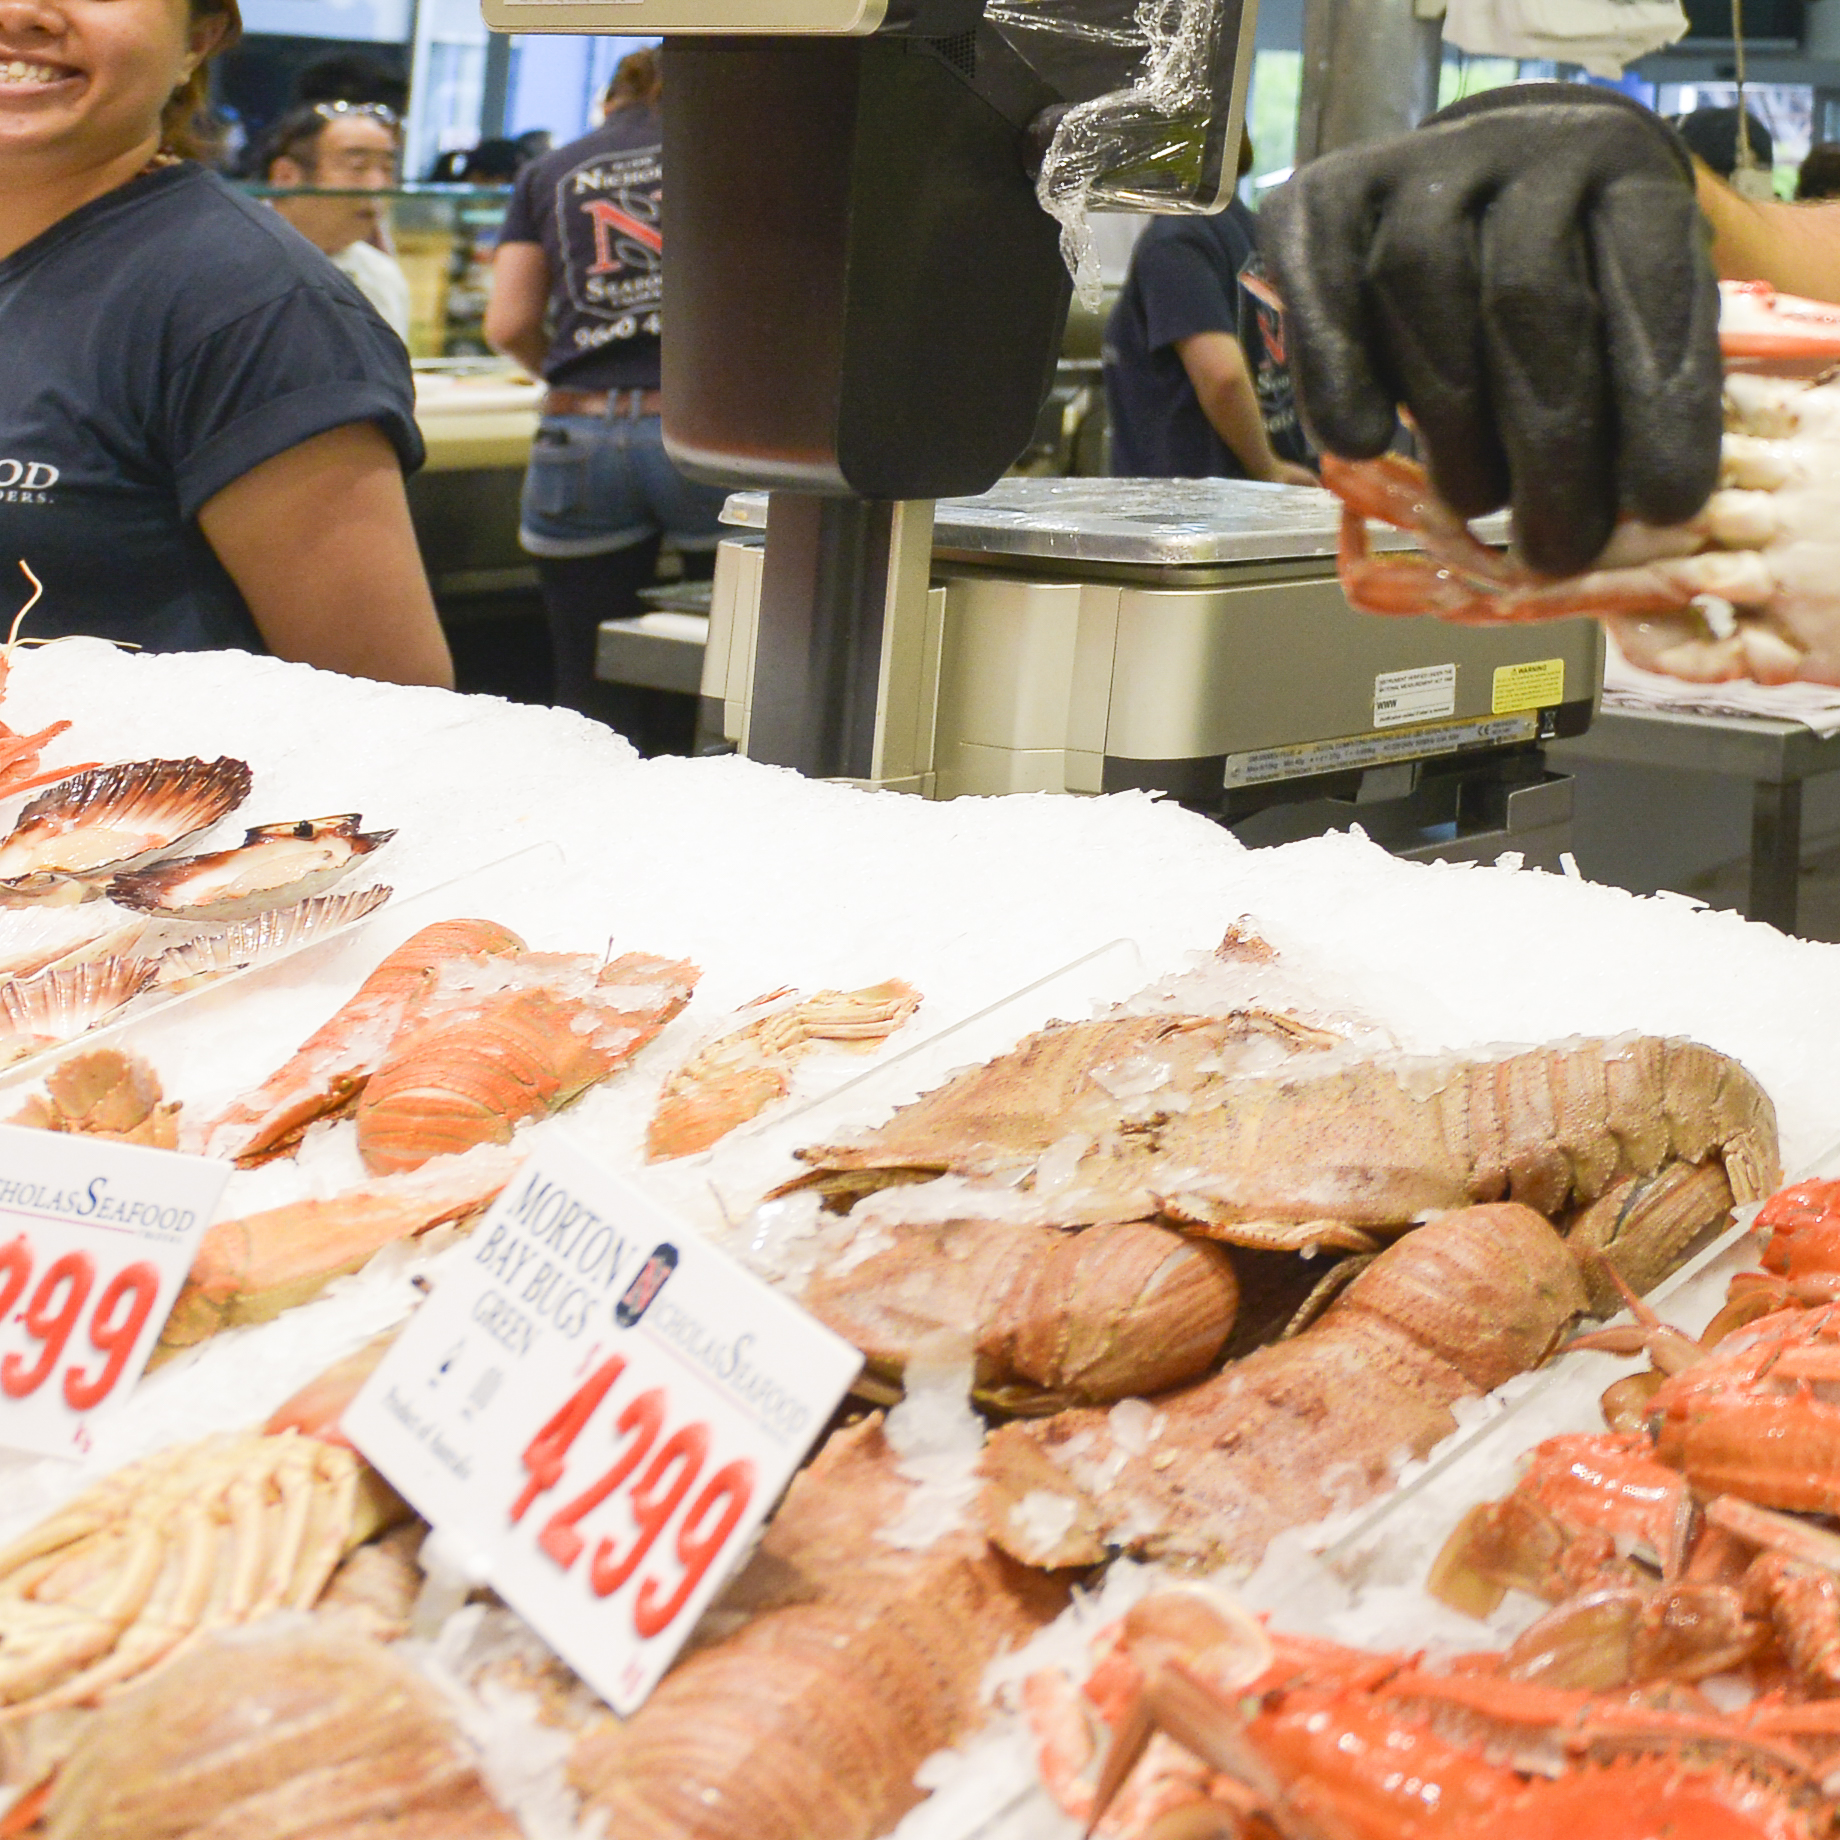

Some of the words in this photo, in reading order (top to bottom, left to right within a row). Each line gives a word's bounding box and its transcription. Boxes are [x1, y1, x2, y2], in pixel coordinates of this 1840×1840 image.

[474, 1223, 529, 1286] BAY
[520, 1264, 598, 1341] BUGS
[505, 1171, 640, 1290] MORTON
[471, 1288, 541, 1360] GREEN
